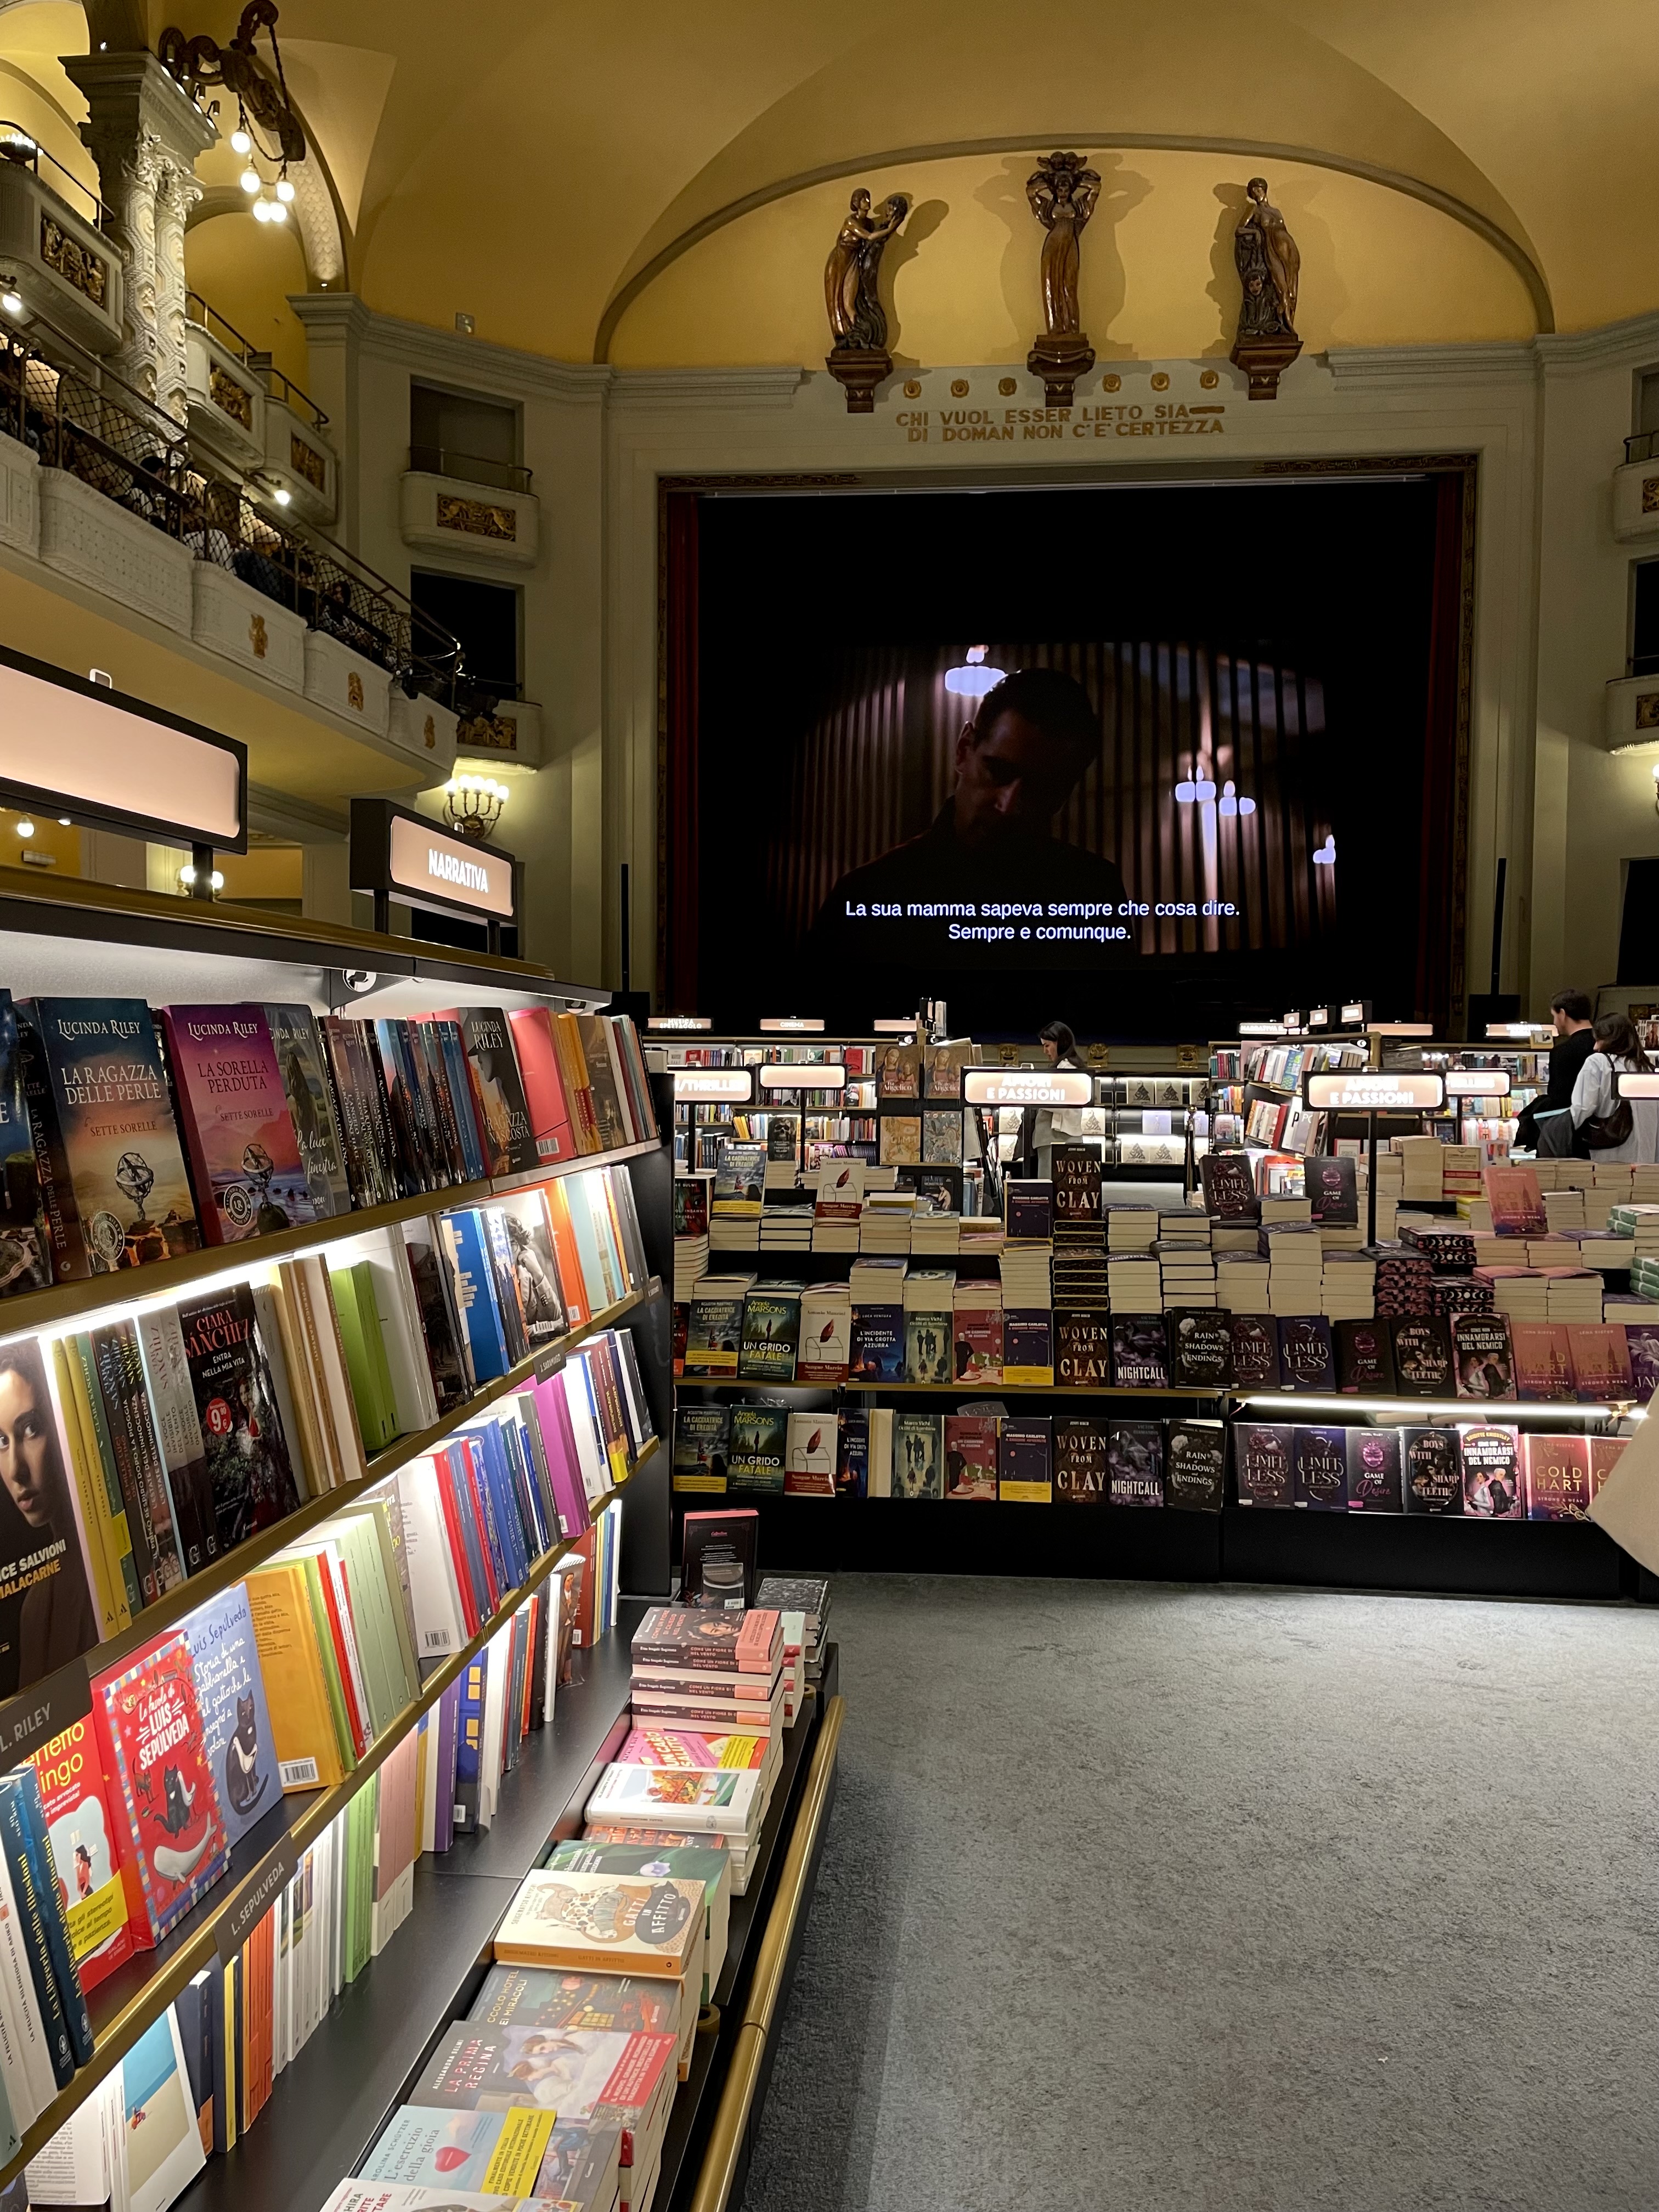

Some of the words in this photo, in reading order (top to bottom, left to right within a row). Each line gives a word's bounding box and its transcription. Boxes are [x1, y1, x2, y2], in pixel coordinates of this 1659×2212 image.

[896, 412, 928, 426] CHI
[940, 410, 994, 425] VUOL
[1005, 408, 1071, 424] ESSER
[1082, 407, 1143, 421] LIETO
[908, 427, 928, 442] DI
[943, 425, 1014, 441] DOMAN
[1024, 425, 1063, 438] NON
[1116, 419, 1224, 436] CERTEZZA
[428, 849, 489, 893] NARRATIVA
[846, 901, 866, 916] La
[872, 904, 902, 916] sua
[907, 904, 976, 916] mamma
[981, 904, 1043, 919] sapeva
[1048, 904, 1113, 918] sempre
[1118, 900, 1149, 916] che
[1155, 904, 1197, 916] cosa
[1202, 900, 1240, 916] dire.
[949, 925, 1015, 943] Sempre
[1020, 928, 1031, 940] e
[1036, 928, 1131, 943] comunque.
[57, 1019, 109, 1041] LUCINDA
[110, 1019, 140, 1039] RILEY
[188, 1022, 232, 1041] LUCINDA
[233, 1022, 258, 1038] RILEY
[471, 1021, 501, 1032] LUCINDA
[473, 1032, 504, 1051] RILEY
[61, 1068, 82, 1085] LA
[84, 1064, 157, 1084] RAGAZZA
[198, 1062, 216, 1078] LA
[217, 1060, 269, 1077] SORELLA
[207, 1076, 267, 1093] PERDUTA
[1001, 1074, 1052, 1087] AMORI
[1345, 1078, 1399, 1091] AMORI
[65, 1085, 114, 1105] DELLE
[116, 1082, 161, 1101] PERLE
[987, 1088, 995, 1099] E
[998, 1088, 1065, 1101] PASSIONI
[1330, 1092, 1339, 1104] E
[1342, 1091, 1414, 1104] PASSIONI
[221, 1110, 243, 1122] SETTE
[244, 1108, 274, 1119] SORELLE
[486, 1111, 527, 1131] RAGAZZA
[90, 1125, 119, 1137] SETTE
[120, 1121, 157, 1133] SORELLE
[489, 1126, 530, 1144] NASCOSTA
[1056, 1160, 1101, 1172] WOVEN
[1056, 1191, 1099, 1209] CLAY
[747, 1305, 787, 1314] MARSONS
[196, 1310, 233, 1332] CLARA
[1059, 1327, 1107, 1340] WOVEN
[1409, 1328, 1430, 1336] BOYS
[1457, 1333, 1505, 1342] INNAMORARSI
[743, 1341, 757, 1350] UN
[759, 1342, 791, 1352] GRIDO
[1073, 1342, 1094, 1352] FROM
[1396, 1338, 1419, 1346] WITH
[1476, 1341, 1503, 1350] NEMICO
[213, 1352, 232, 1364] ENTRA
[749, 1350, 782, 1361] FATALE
[1187, 1355, 1222, 1363] ENDINGS
[202, 1367, 222, 1379] NELLA
[222, 1361, 233, 1372] MIA
[234, 1357, 245, 1367] VITA
[1060, 1358, 1107, 1378] CLAY
[1421, 1359, 1448, 1368] SHARP
[1118, 1367, 1165, 1380] NIGHTCALL
[211, 1408, 221, 1432] 9
[691, 1416, 723, 1424] CACCIATRICE
[733, 1416, 774, 1425] MARSONS
[166, 1413, 178, 1453] INVISIBILE
[184, 1435, 189, 1445] LA
[165, 1442, 171, 1453] LA
[1056, 1435, 1106, 1450] WOVEN
[1423, 1440, 1443, 1448] BOYS
[1070, 1452, 1092, 1464] FROM
[1186, 1451, 1207, 1460] RAIN
[1409, 1451, 1431, 1459] WITH
[1464, 1447, 1513, 1456] INNAMORARSI
[731, 1455, 745, 1464] UN
[747, 1456, 780, 1466] GRIDO
[1468, 1457, 1482, 1465] DEL
[1483, 1457, 1510, 1465] NEMICO
[738, 1464, 772, 1475] FATALE
[1175, 1462, 1215, 1474] SHADOWS
[1536, 1466, 1582, 1479] COLD
[1057, 1470, 1105, 1491] CLAY
[1176, 1474, 1212, 1486] ENDINGS
[1248, 1468, 1285, 1483] LESS
[1300, 1471, 1341, 1487] LESS
[1431, 1474, 1459, 1484] SHARP
[1111, 1480, 1160, 1496] NIGHTCALL
[1536, 1479, 1582, 1492] HART
[19, 1539, 66, 1572] SALVIONI
[14, 1702, 51, 1740] RILEY
[149, 1702, 172, 1736] LUIS
[139, 1713, 189, 1770] SEPÚLVEDA
[232, 1923, 240, 1936] L.
[240, 1861, 284, 1925] SEPULVEDA
[623, 1898, 648, 1926] GATTI
[651, 1893, 676, 1934] AFFITTO
[444, 2079, 462, 2093] LA
[455, 2039, 483, 2074] PRIMA
[465, 2045, 496, 2089] REGINA
[384, 2127, 424, 2181] L'esercizio
[403, 2155, 426, 2182] della
[421, 2129, 440, 2154] gioia
